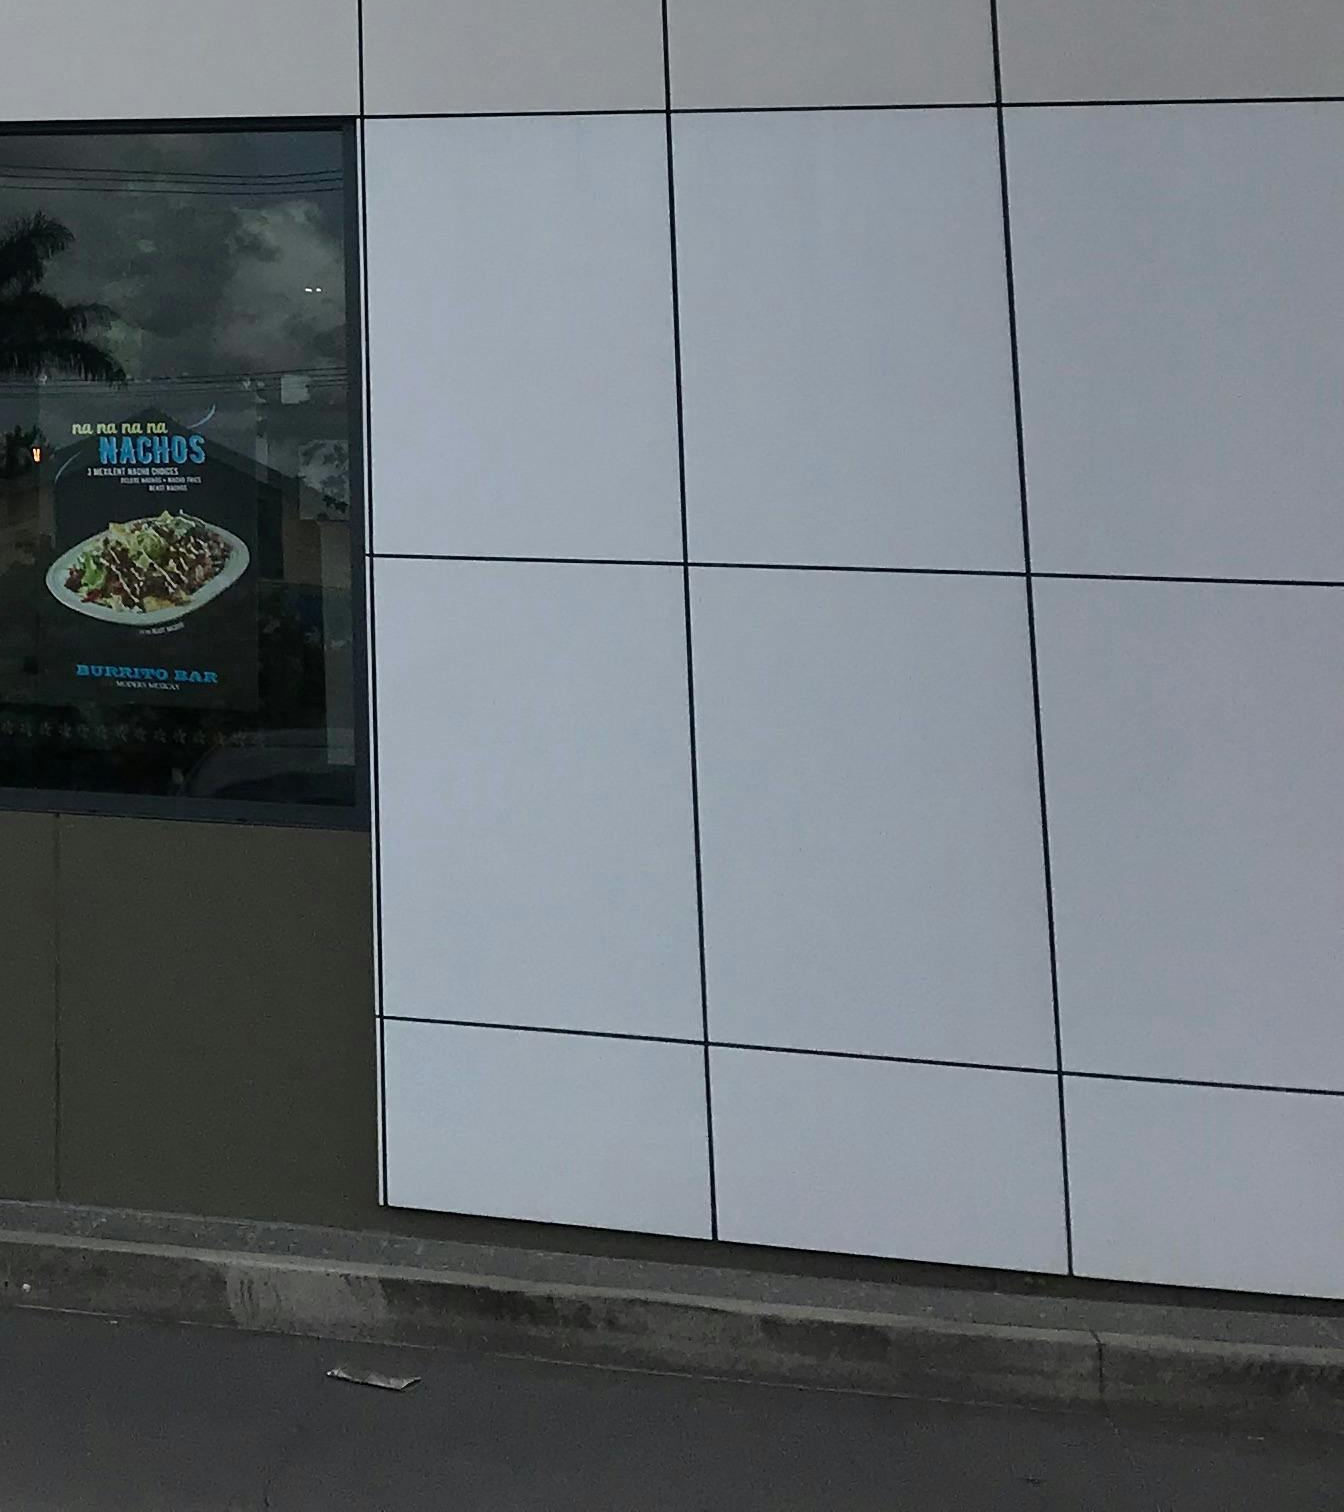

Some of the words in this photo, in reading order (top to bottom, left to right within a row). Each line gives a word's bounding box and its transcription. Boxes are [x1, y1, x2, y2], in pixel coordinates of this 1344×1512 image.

[72, 423, 93, 435] na
[96, 423, 118, 435] na
[121, 422, 143, 434] na
[146, 422, 169, 434] na
[98, 434, 207, 465] NACHOS
[75, 664, 169, 681] BURRITO
[173, 669, 219, 684] BAR
